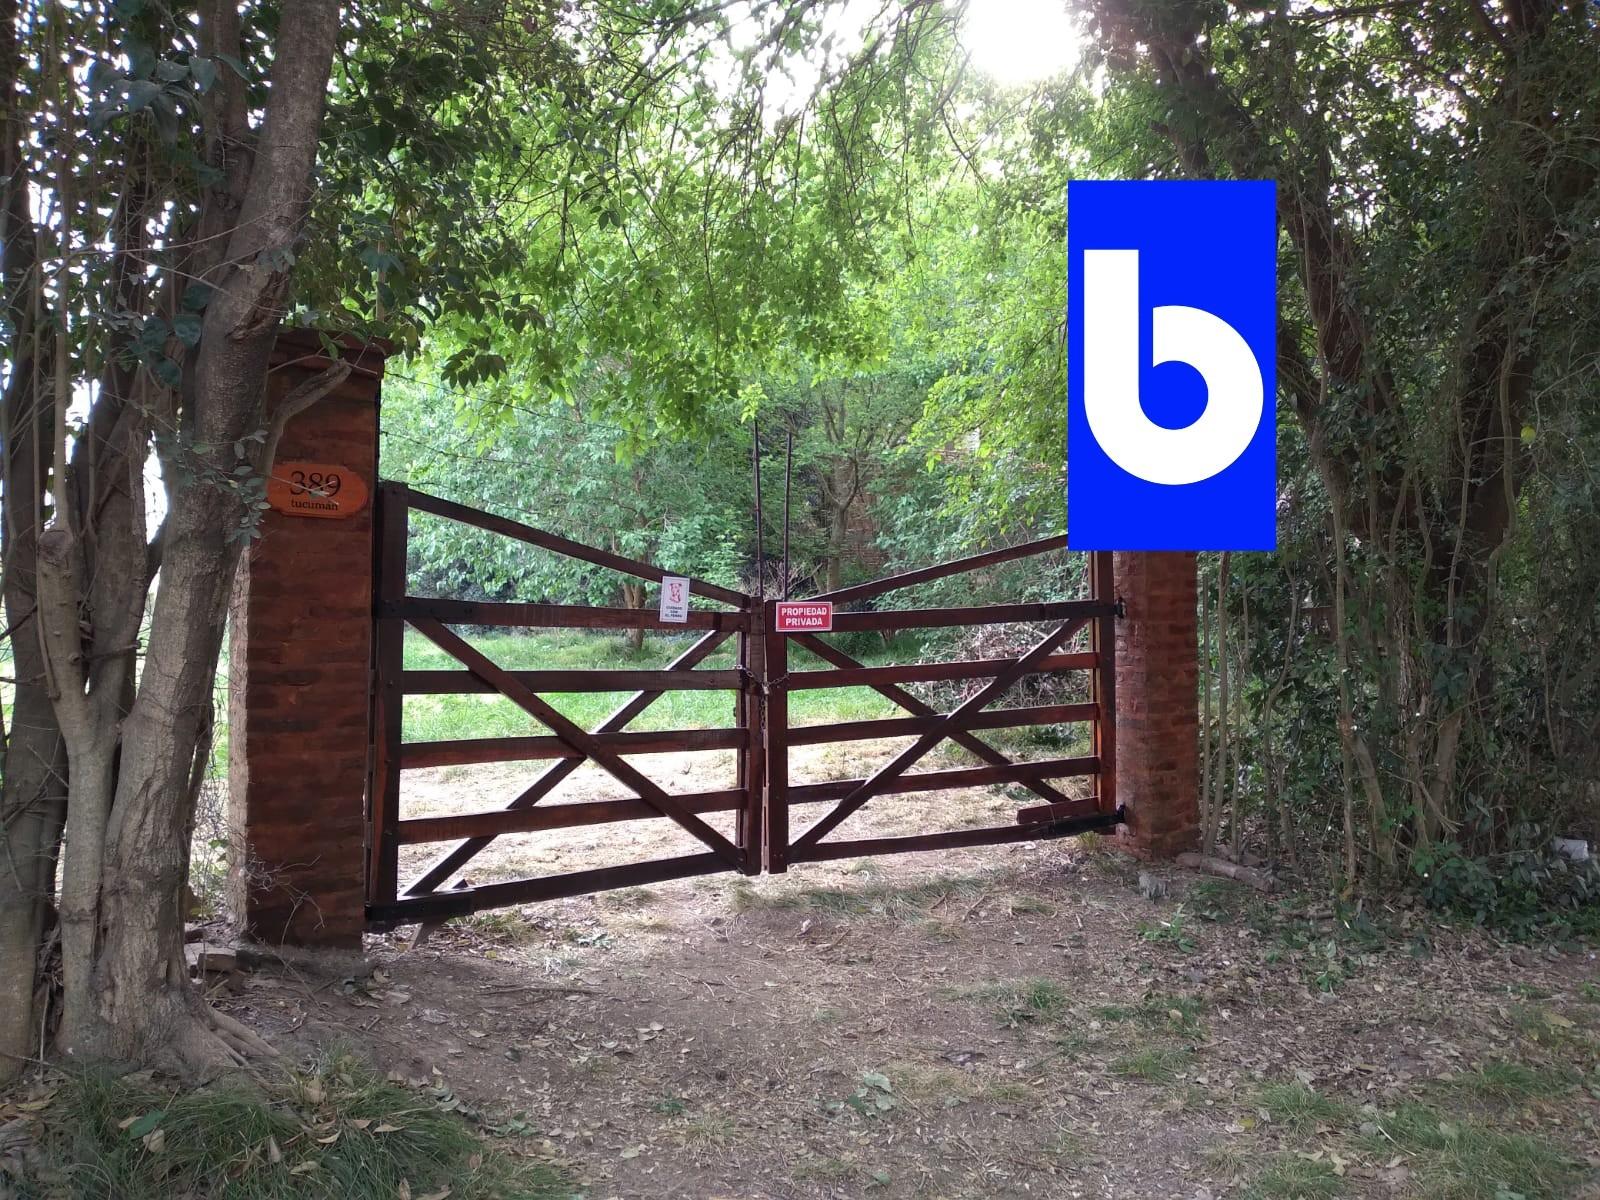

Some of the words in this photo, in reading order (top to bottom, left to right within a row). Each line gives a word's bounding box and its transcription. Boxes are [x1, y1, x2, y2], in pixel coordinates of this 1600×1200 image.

[289, 470, 341, 497] 389
[781, 607, 828, 616] PROPIEDAD
[785, 617, 823, 626] PRIVADA
